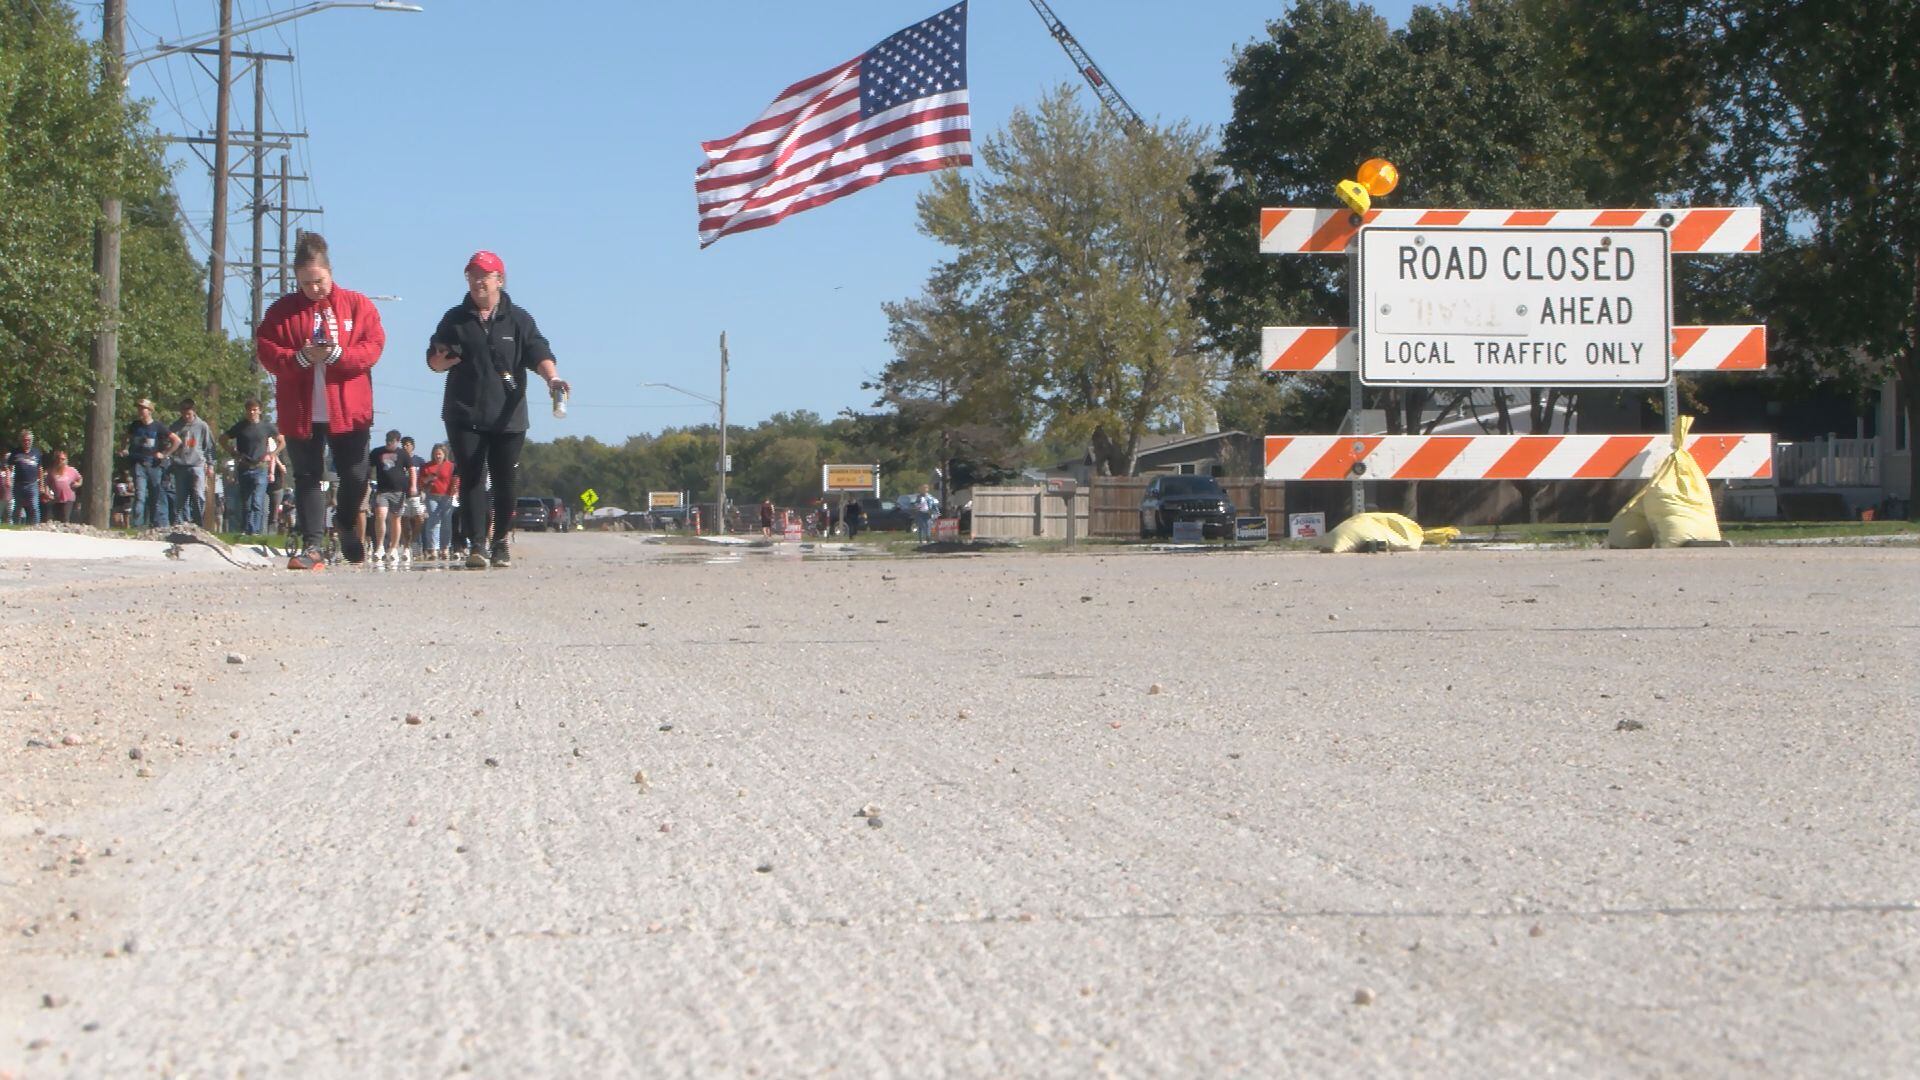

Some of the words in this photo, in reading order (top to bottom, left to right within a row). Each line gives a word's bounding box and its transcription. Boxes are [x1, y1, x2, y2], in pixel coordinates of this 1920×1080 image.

[1400, 246, 1487, 279] ROAD
[1503, 246, 1634, 281] CLOSED
[1541, 297, 1632, 324] AHEAD
[1385, 342, 1454, 363] LOCAL
[1475, 343, 1566, 364] TRAFFIC
[1586, 343, 1643, 364] ONLY
